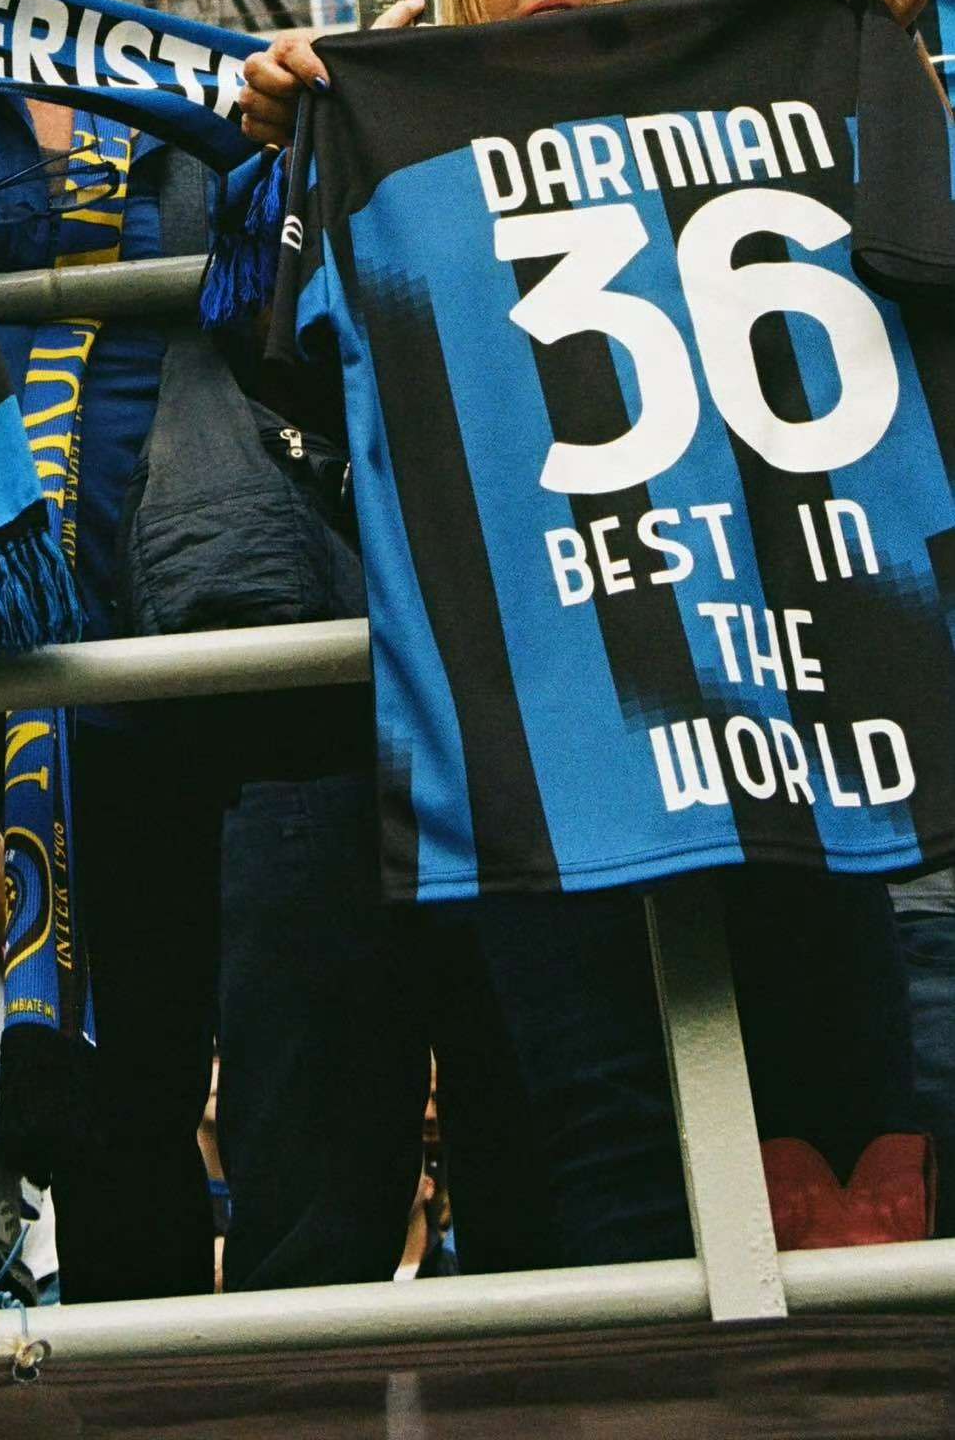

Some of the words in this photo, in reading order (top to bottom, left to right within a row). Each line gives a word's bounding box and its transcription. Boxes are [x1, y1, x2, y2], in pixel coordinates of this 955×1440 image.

[471, 100, 835, 213] DARMIAN
[494, 188, 900, 495] 36
[544, 502, 737, 607] BEST
[797, 499, 879, 582] IN
[697, 601, 825, 692] THE
[648, 714, 916, 812] WORLD
